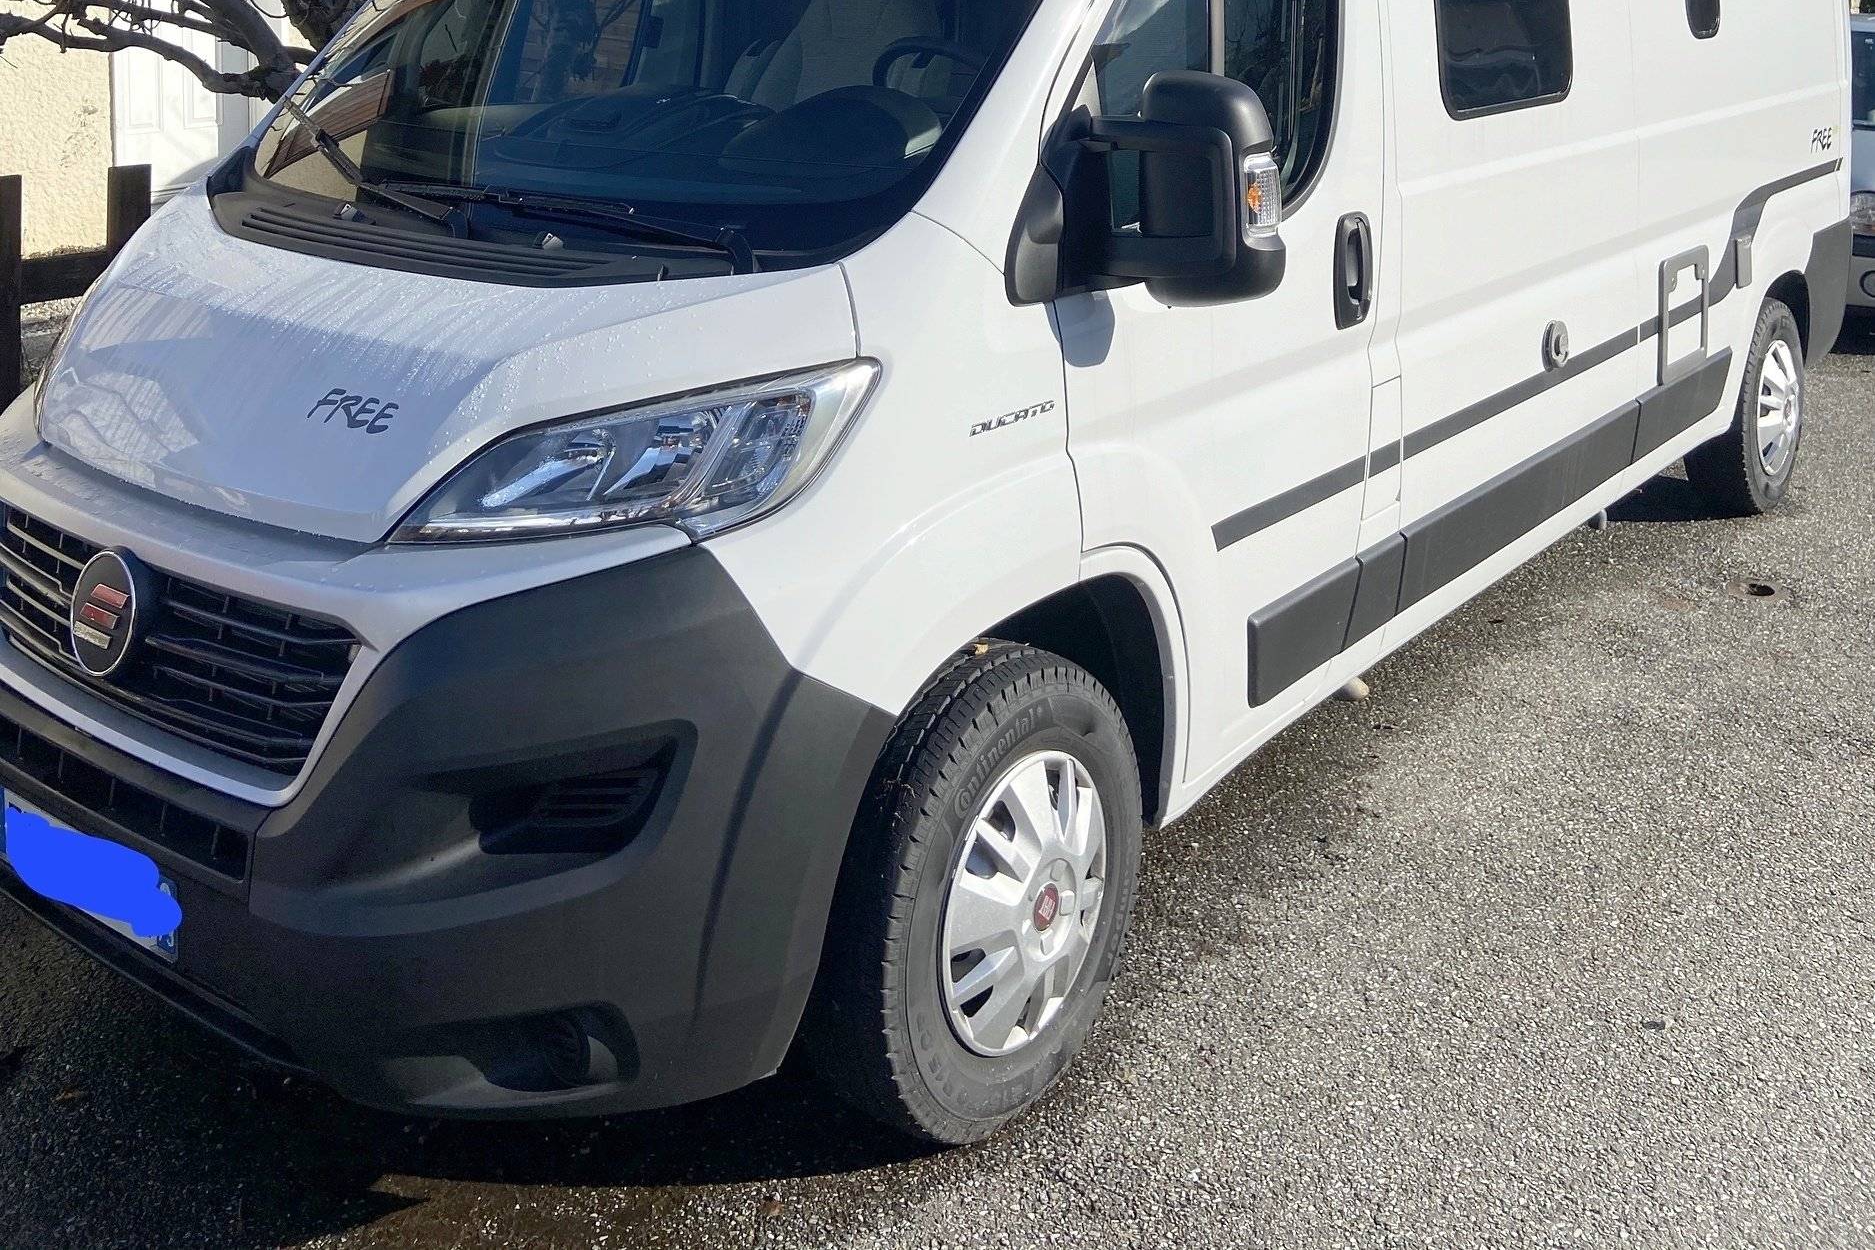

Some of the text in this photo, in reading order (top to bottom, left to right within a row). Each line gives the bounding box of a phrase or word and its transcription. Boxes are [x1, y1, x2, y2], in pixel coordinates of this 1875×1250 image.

[1811, 127, 1832, 153] FREE
[307, 388, 399, 434] FREE
[969, 400, 1054, 437] DUCATO
[954, 708, 1035, 818] Continental
